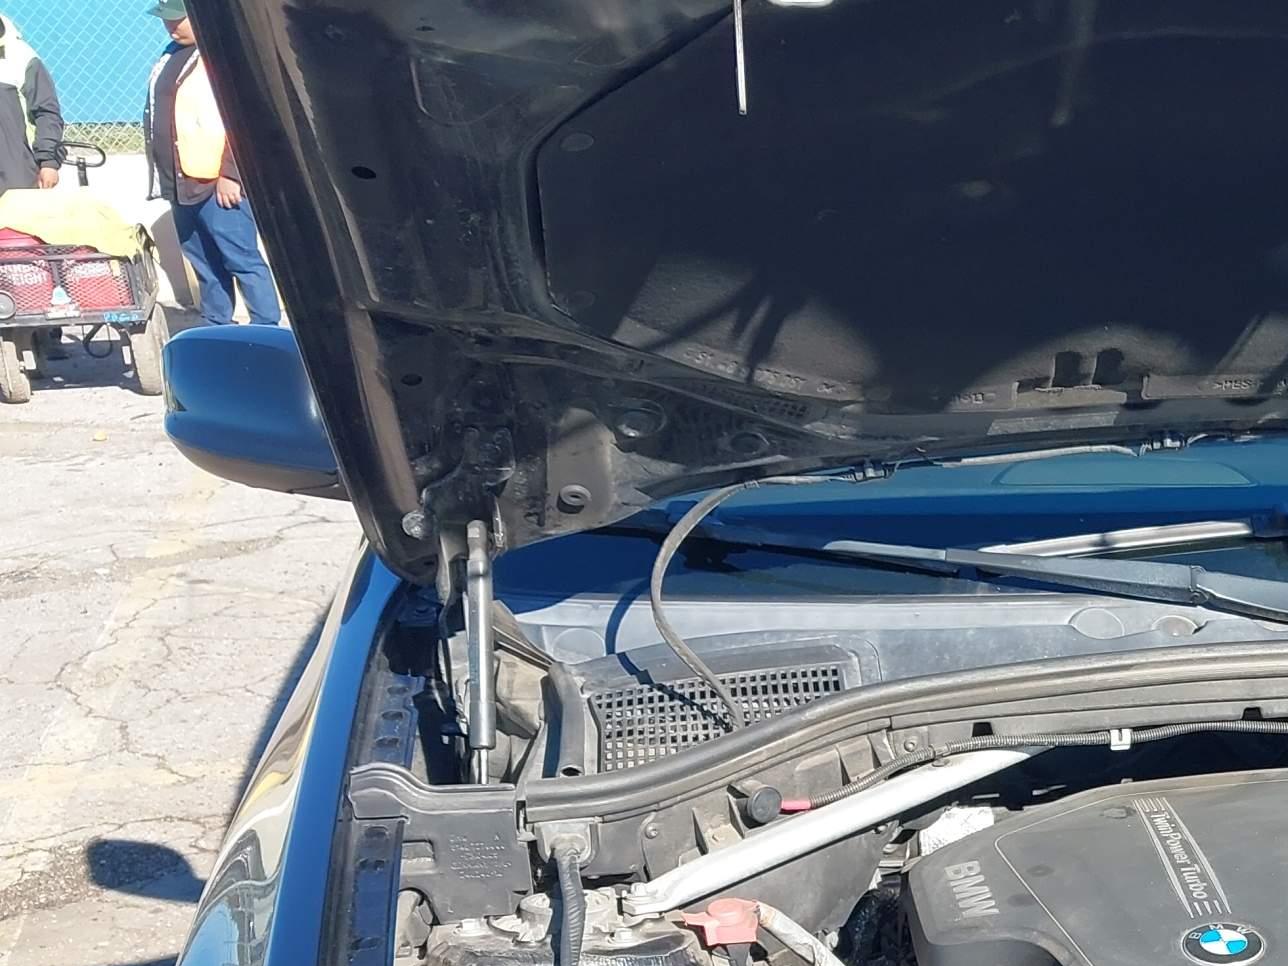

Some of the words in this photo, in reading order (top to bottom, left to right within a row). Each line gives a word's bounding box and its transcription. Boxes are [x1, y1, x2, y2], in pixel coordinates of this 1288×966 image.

[943, 860, 1000, 919] BMW
[1150, 810, 1192, 865] TwinPower
[1179, 863, 1208, 900] Turbo
